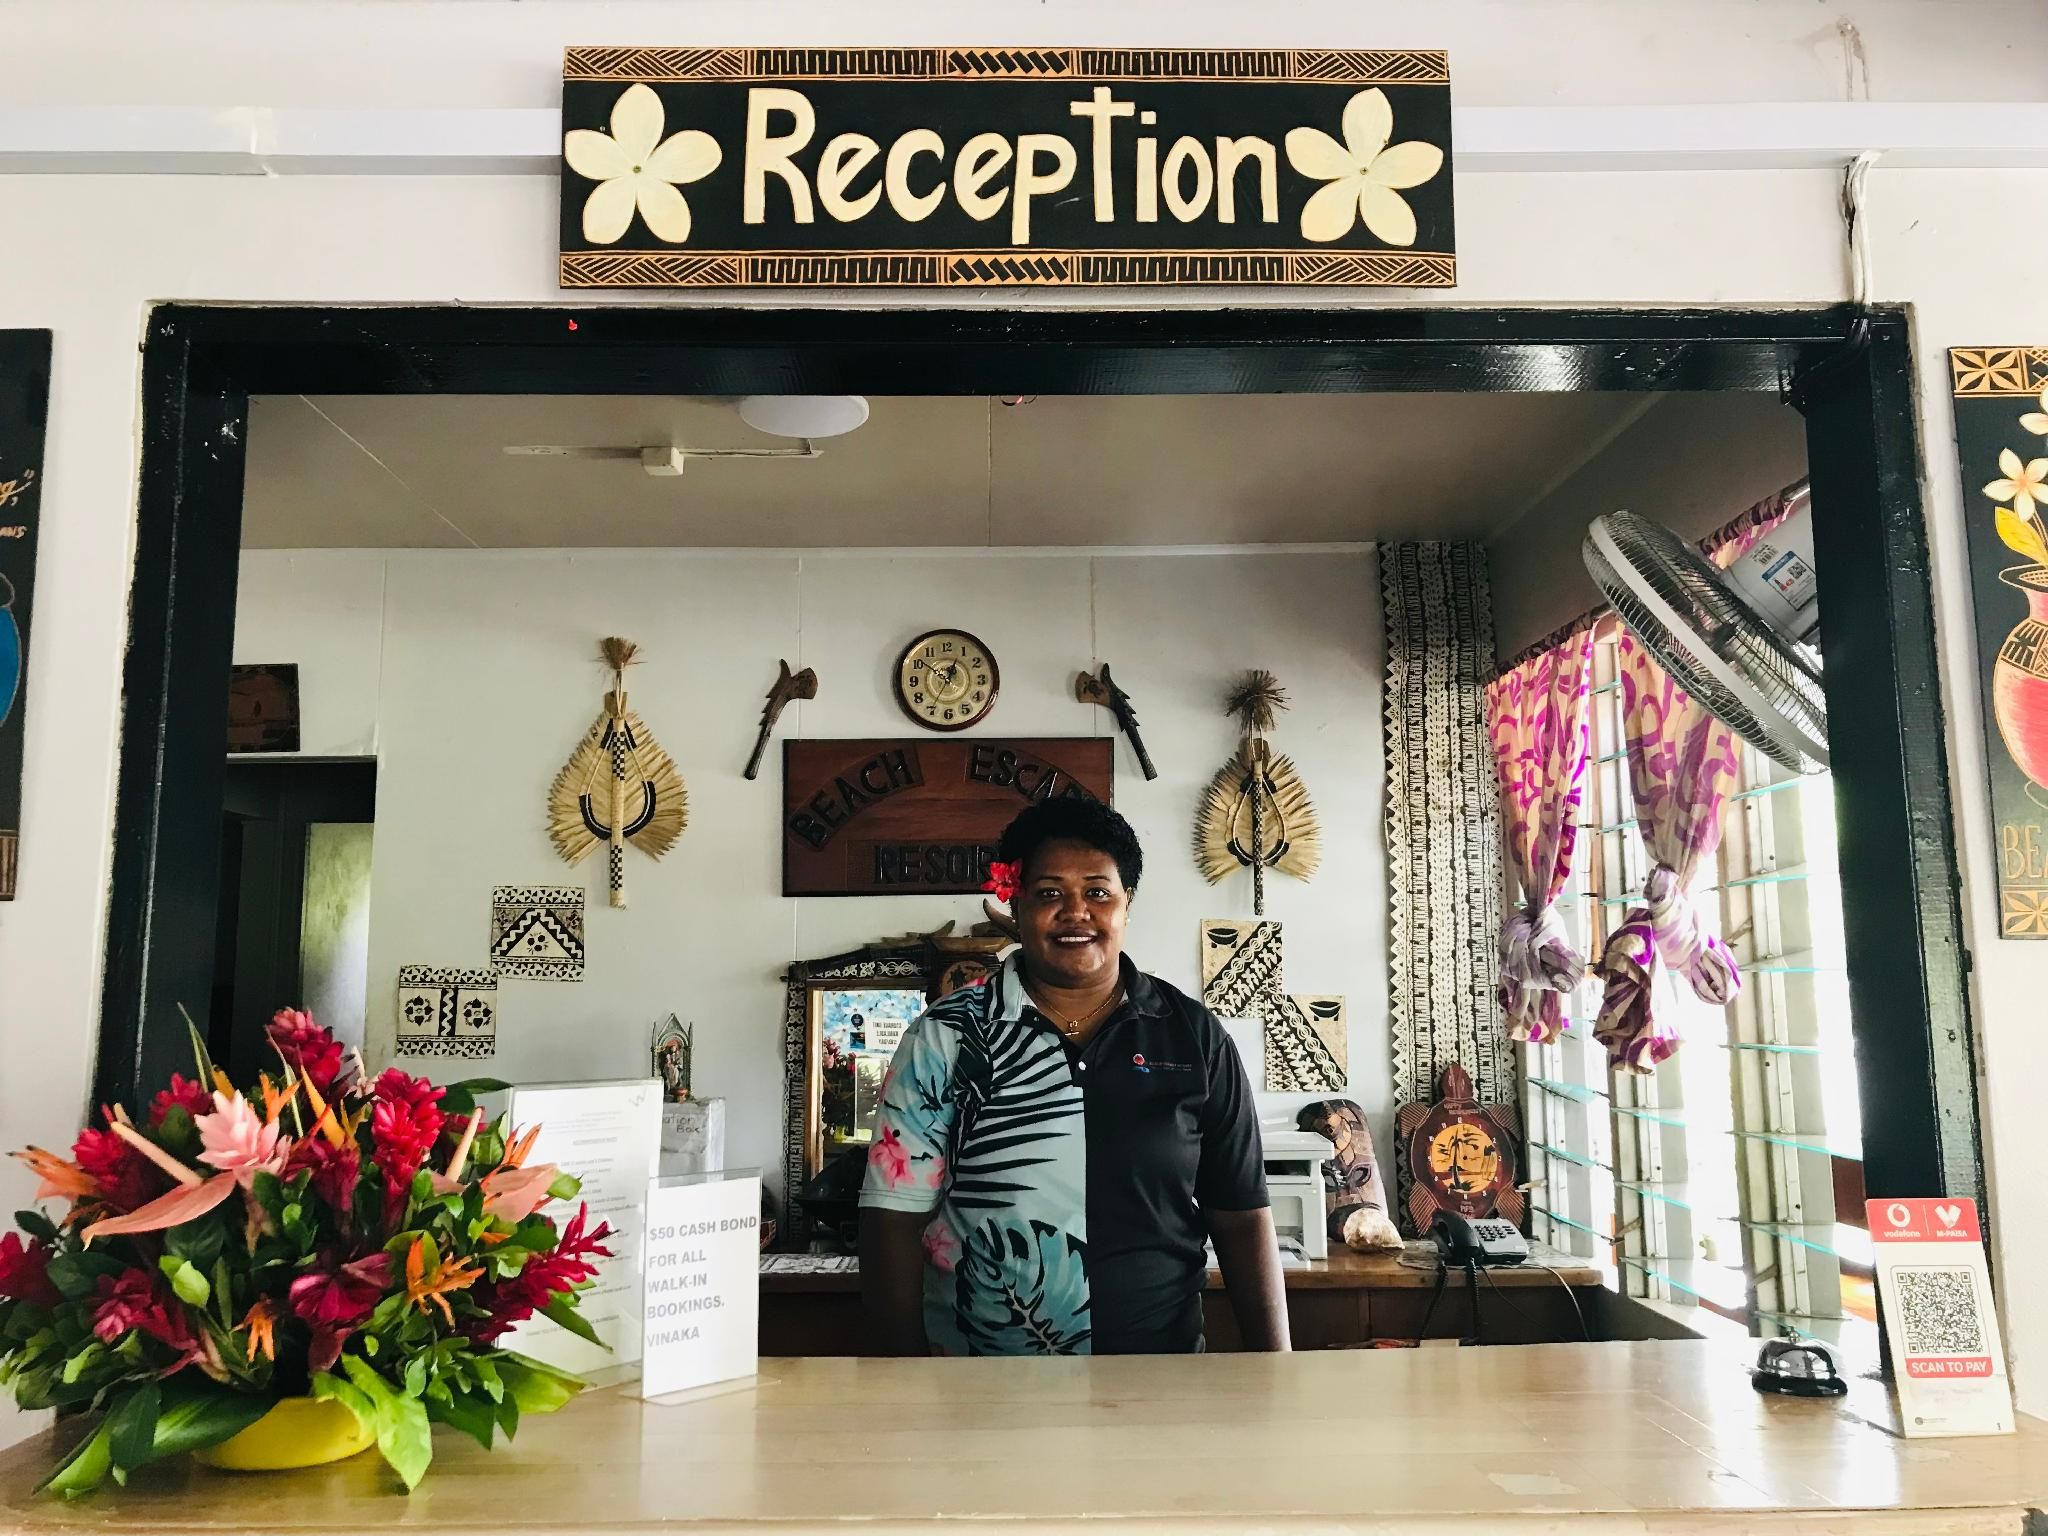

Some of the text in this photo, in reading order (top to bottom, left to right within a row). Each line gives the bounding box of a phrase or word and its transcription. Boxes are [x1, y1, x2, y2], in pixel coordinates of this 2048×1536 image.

[743, 85, 1279, 245] Reception
[925, 647, 935, 657] 11
[941, 641, 953, 653] 12
[961, 646, 966, 657] 1
[913, 658, 924, 670] 10
[971, 657, 981, 668] 2
[909, 675, 919, 688] 9
[977, 674, 986, 686] 3
[913, 692, 924, 704] 8
[972, 691, 981, 702] 4
[926, 705, 937, 716] 7
[943, 708, 954, 720] 6
[960, 703, 971, 715] 5
[789, 743, 1080, 848] BEACH ESCA
[2003, 824, 2048, 880] BE
[876, 846, 1000, 885] RESOR
[649, 1216, 757, 1241] $50 CASH BOND
[1884, 1230, 1921, 1238] vodafone
[649, 1249, 707, 1269] FOR ALL
[648, 1273, 708, 1294] WALK-IN
[646, 1295, 726, 1320] BOOKINGS.
[646, 1326, 701, 1348] VINAKA
[1911, 1361, 1987, 1374] SCAN TO PAY
